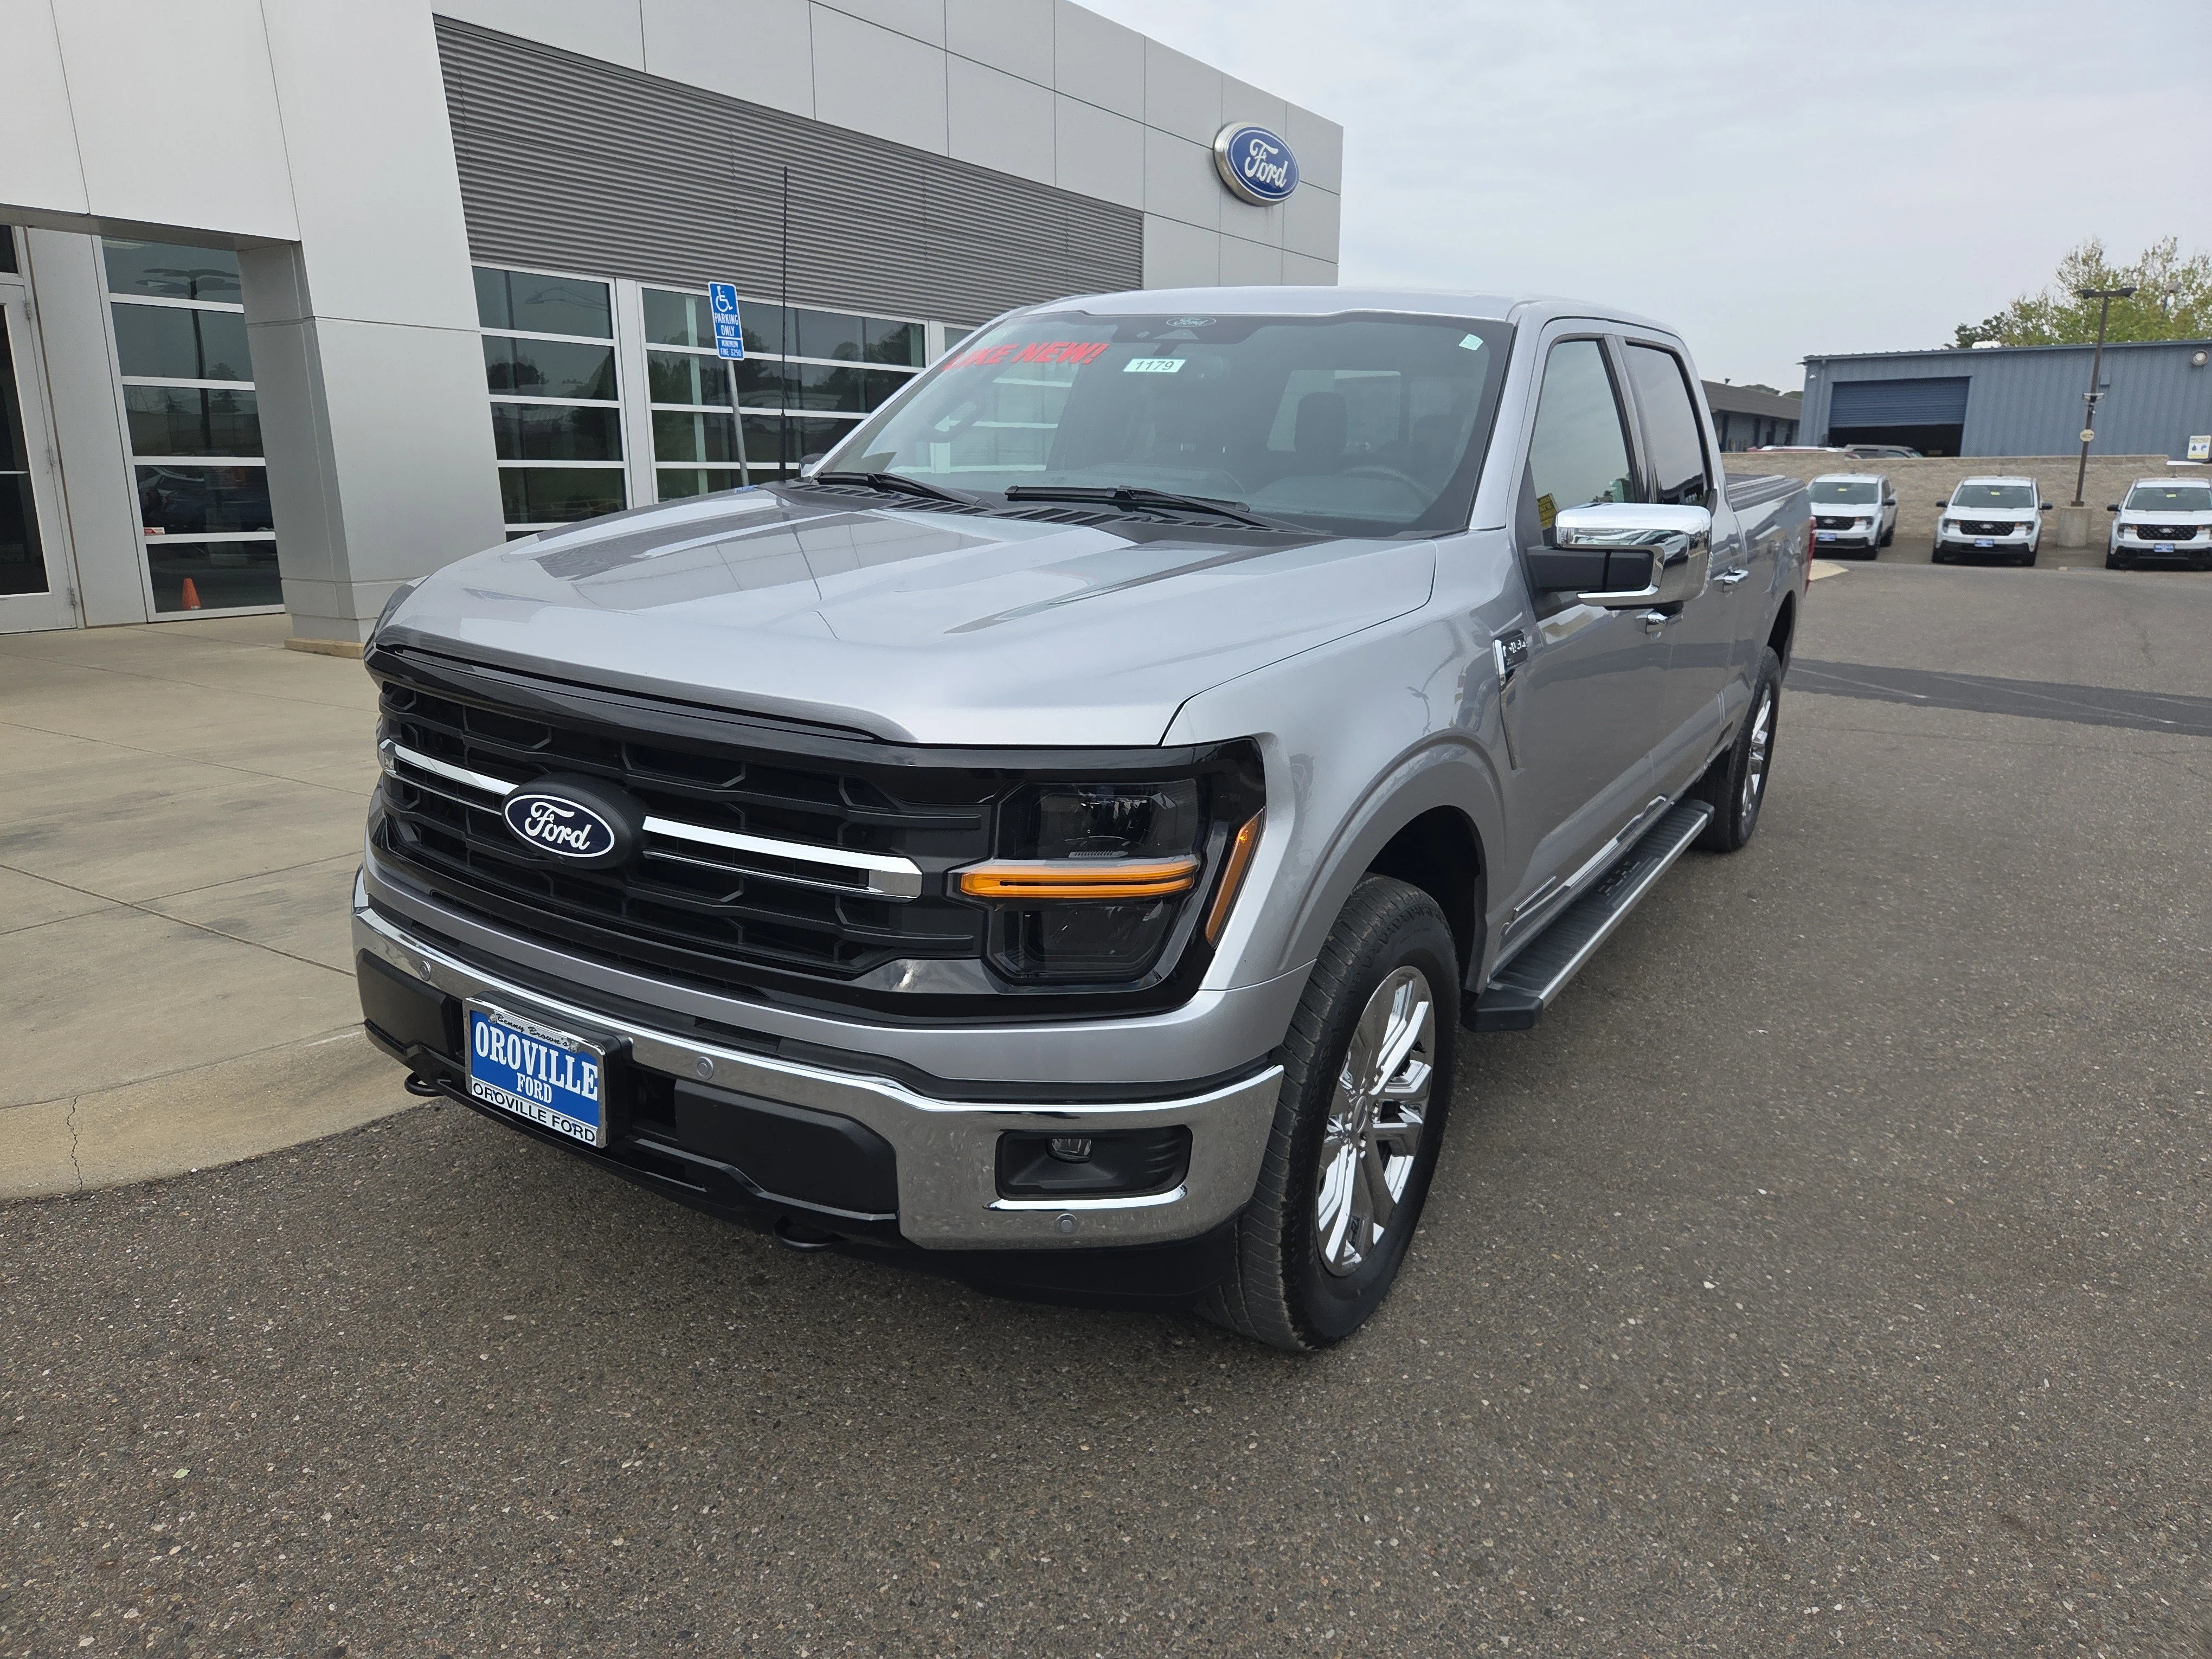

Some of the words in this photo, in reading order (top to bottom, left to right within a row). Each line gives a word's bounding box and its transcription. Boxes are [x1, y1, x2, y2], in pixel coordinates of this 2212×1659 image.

[1244, 138, 1289, 188] Ford
[714, 312, 739, 325] PARKING
[721, 325, 735, 337] ONLY
[1010, 341, 1109, 365] NEW!
[1135, 361, 1174, 370] 1179
[524, 801, 592, 850] Ford
[496, 1013, 525, 1033] Benny
[528, 1026, 569, 1047] Brown's
[475, 1021, 598, 1101] OROVILLE
[517, 1072, 552, 1103] FORD
[473, 1083, 547, 1123] OROVILLE
[552, 1114, 595, 1143] FORD
